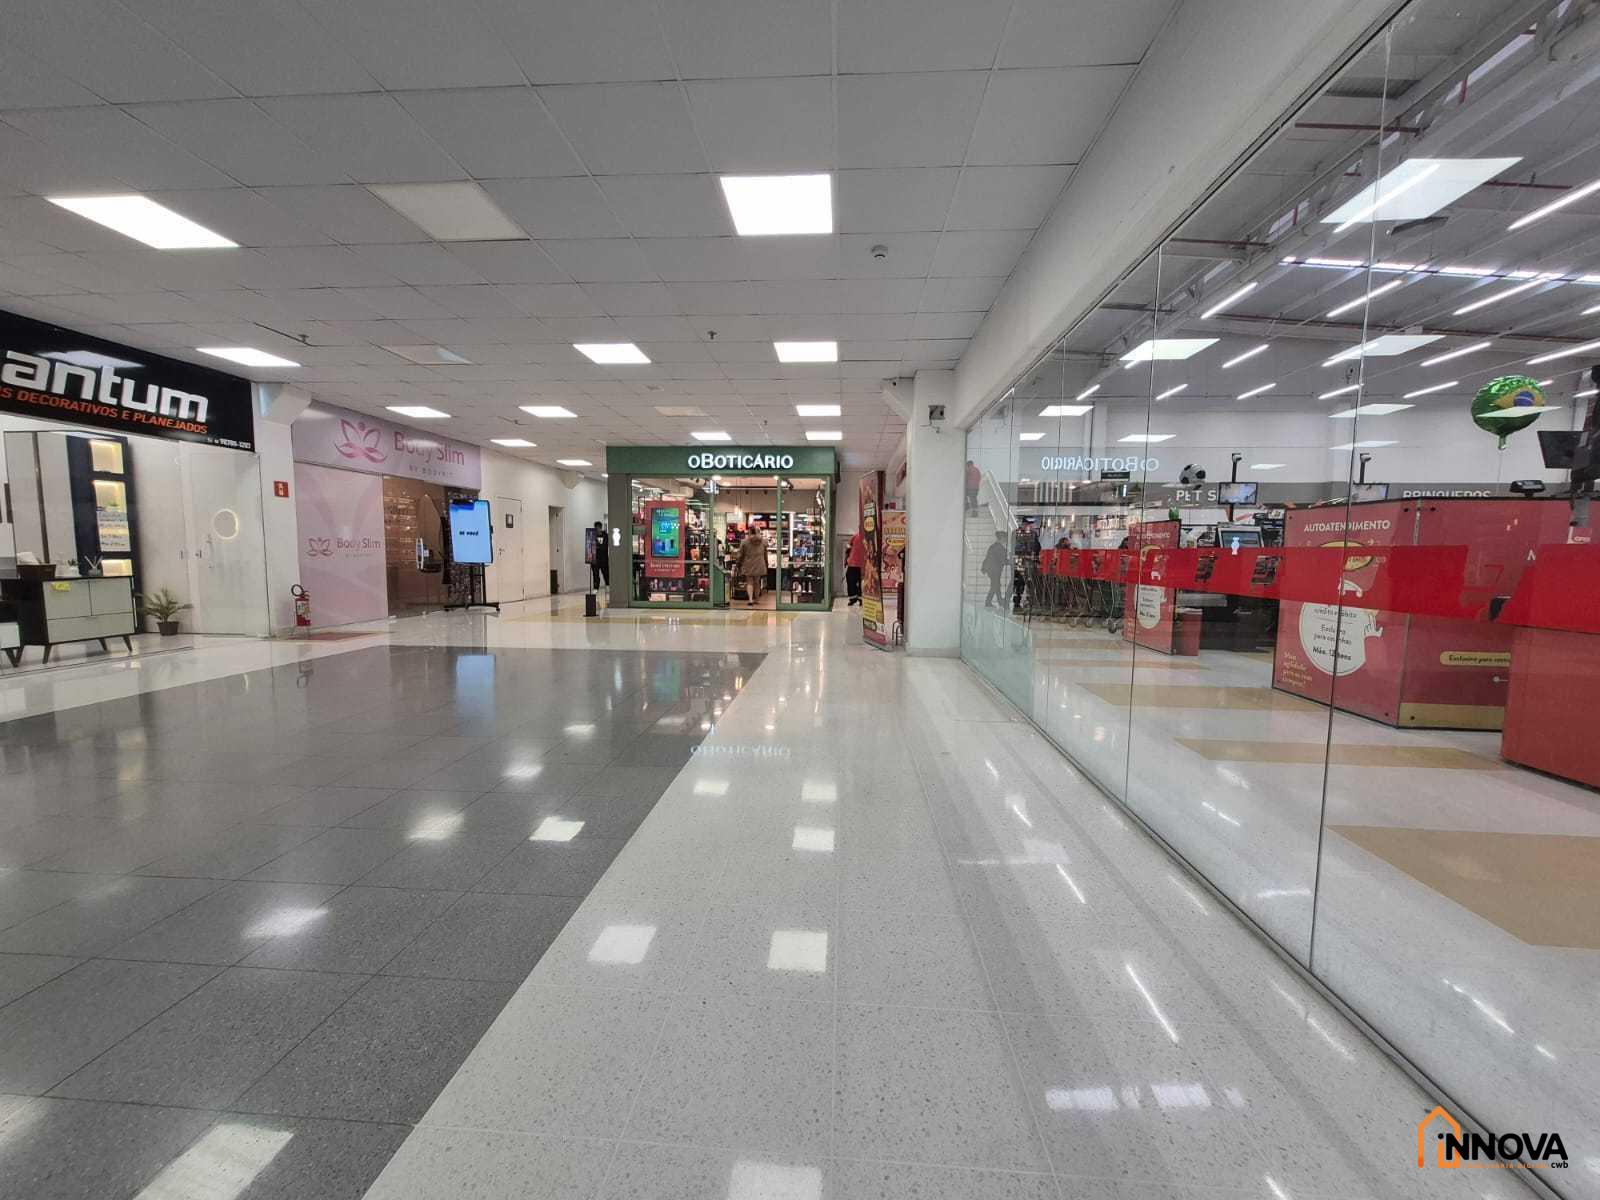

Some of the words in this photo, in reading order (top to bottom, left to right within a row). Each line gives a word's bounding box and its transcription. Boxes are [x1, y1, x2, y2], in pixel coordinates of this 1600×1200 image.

[1, 351, 209, 423] antum
[18, 391, 118, 418] DECORATIVOS
[122, 412, 130, 421] E
[134, 412, 209, 434] PLANEJADOS
[437, 442, 465, 466] Slim
[1303, 519, 1391, 533] AUTOATENDIMENTO
